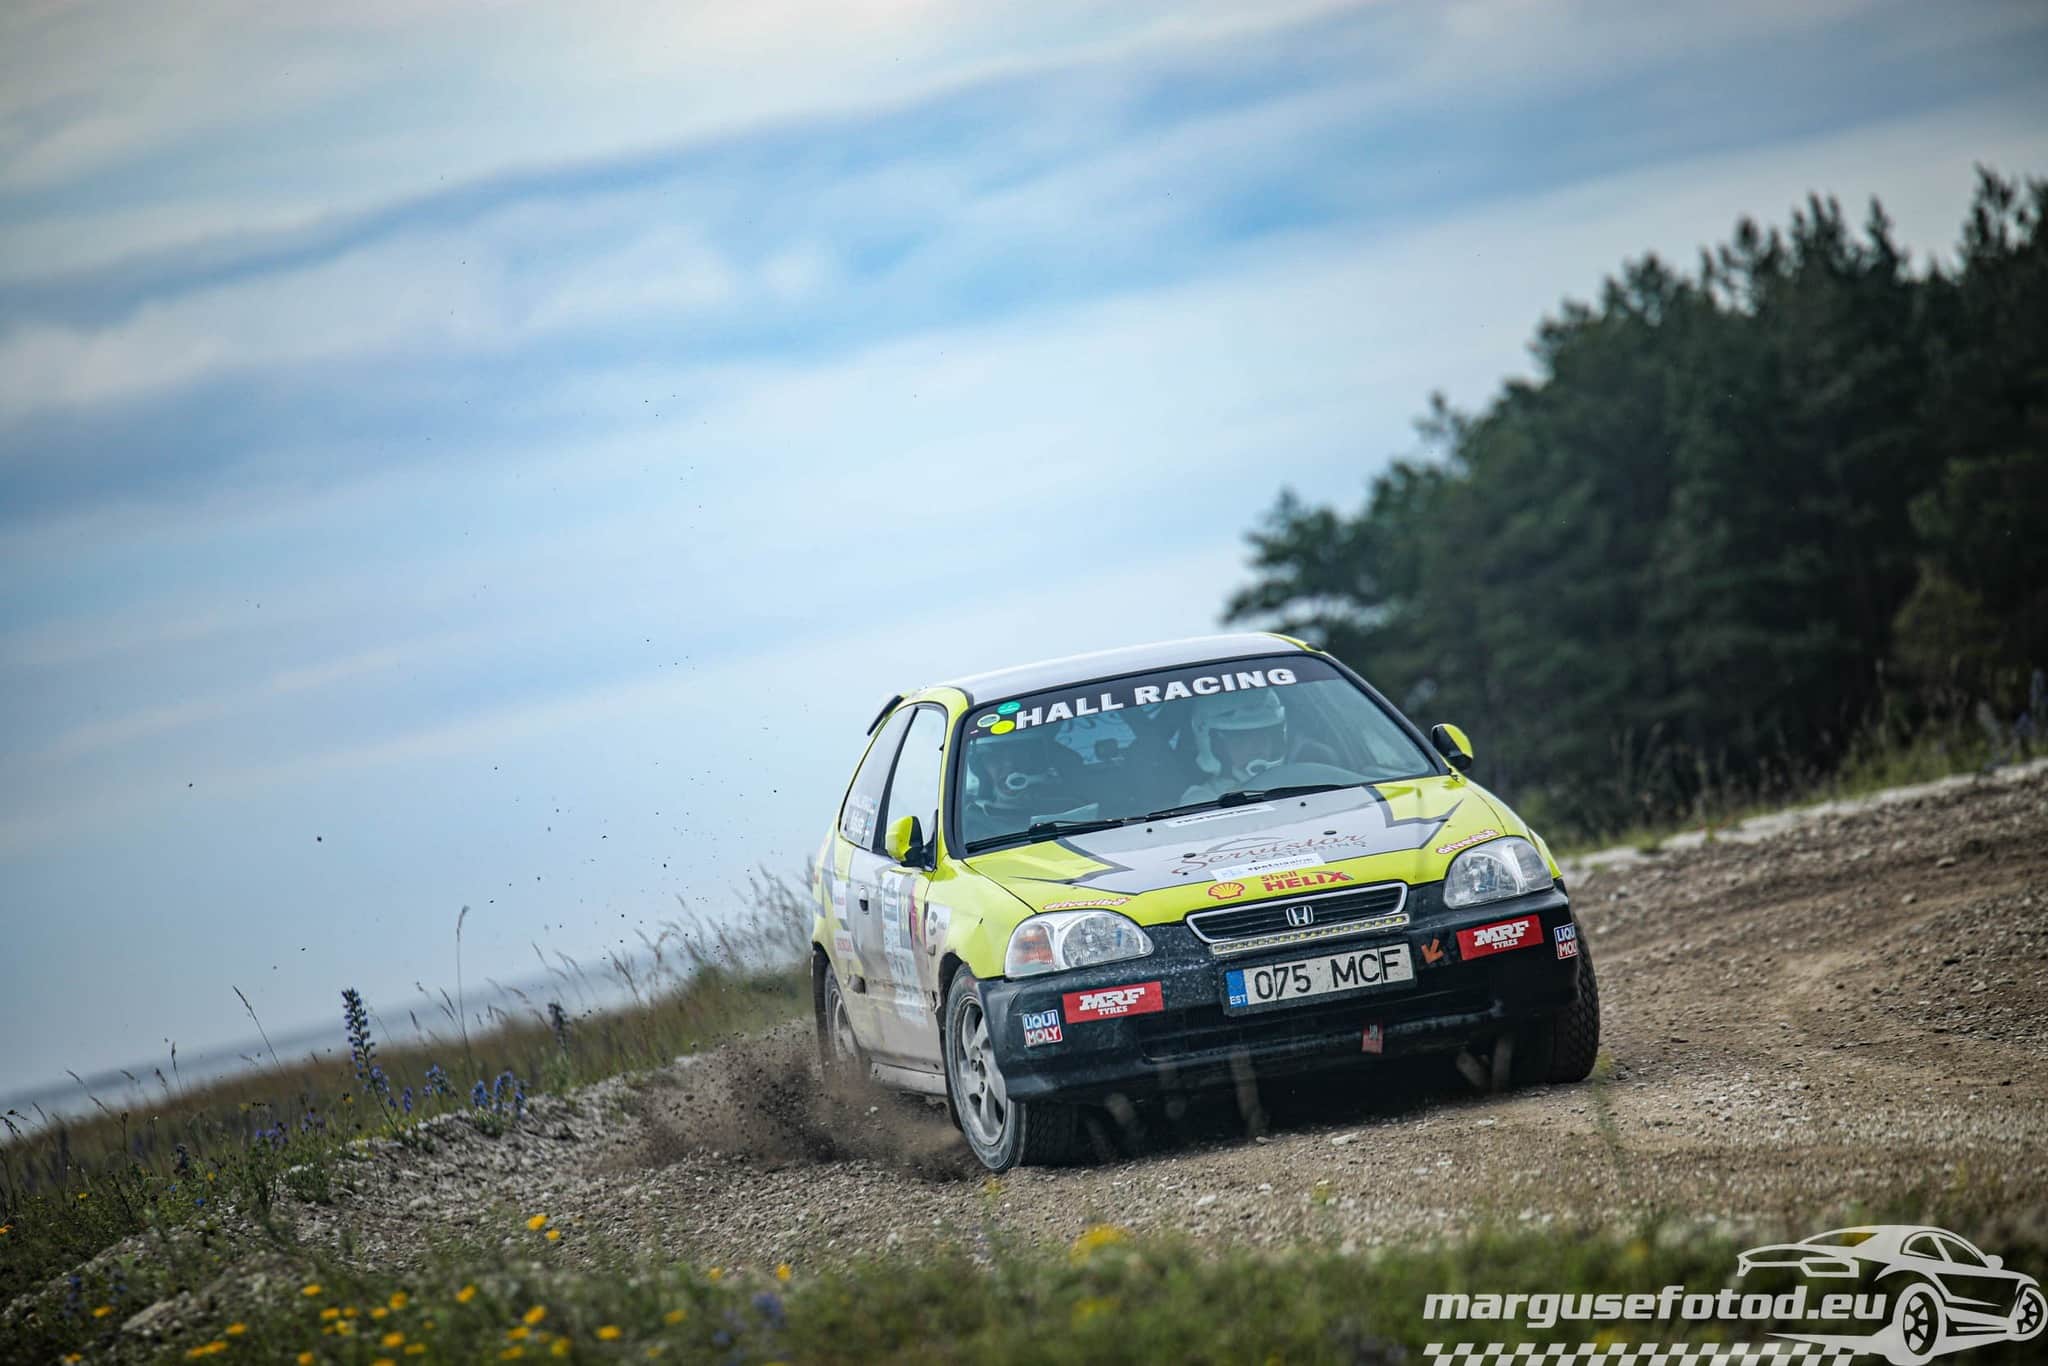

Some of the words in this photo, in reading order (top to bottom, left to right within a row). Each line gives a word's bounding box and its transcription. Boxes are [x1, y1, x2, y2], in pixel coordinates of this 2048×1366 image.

[1015, 692, 1124, 730] HALL
[1134, 668, 1298, 706] RACING
[1260, 870, 1298, 882] Shell
[1263, 871, 1352, 893] HELIX
[1473, 920, 1530, 947] MRF
[1556, 923, 1576, 941] LIQU
[1492, 938, 1518, 950] TYRES
[1254, 963, 1312, 1000] 075
[1330, 948, 1401, 988] MCF
[1079, 986, 1145, 1012] MRF
[1229, 994, 1247, 1006] EST
[1098, 1005, 1129, 1016] TYRES
[1024, 1012, 1057, 1031] LIQUI
[1025, 1026, 1059, 1047] MOLY
